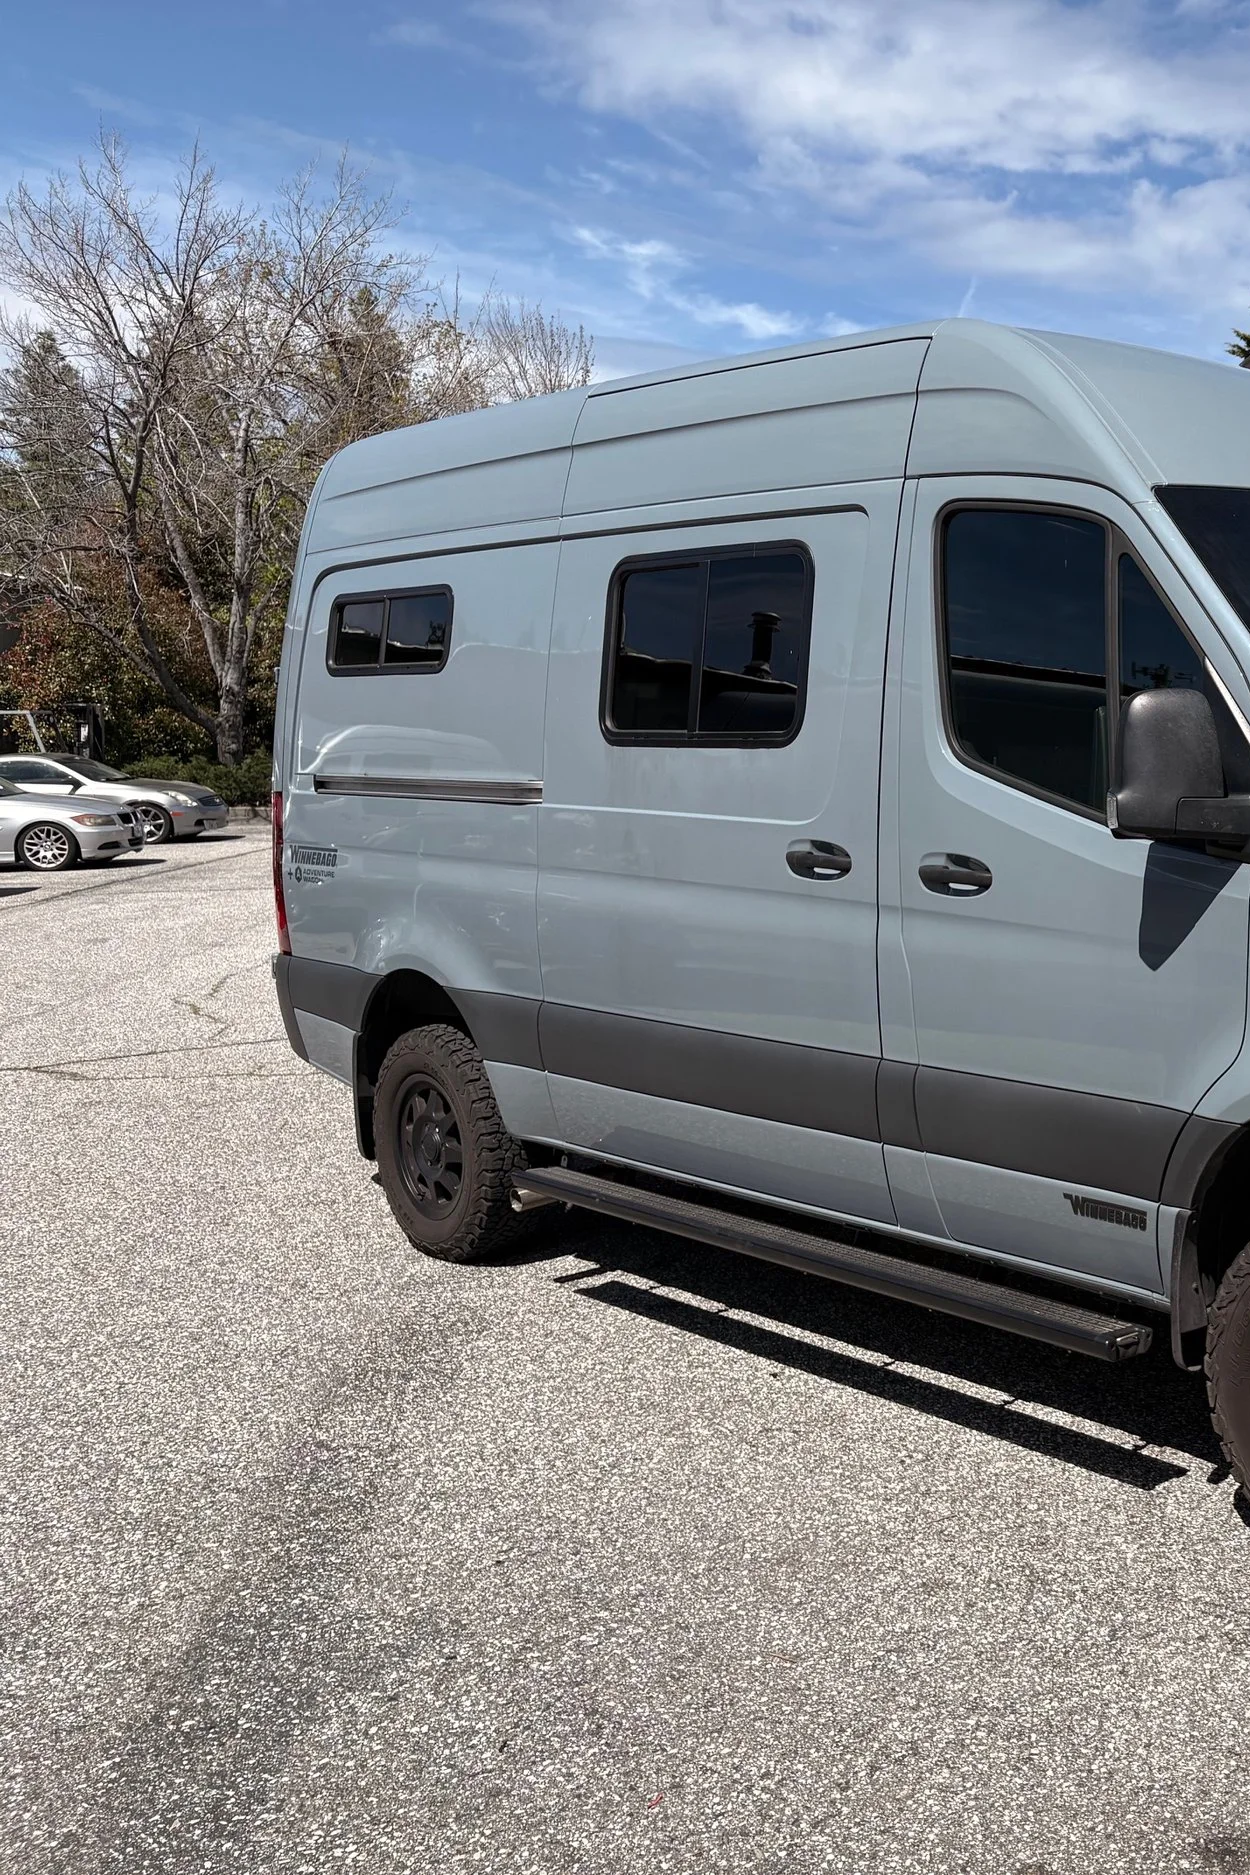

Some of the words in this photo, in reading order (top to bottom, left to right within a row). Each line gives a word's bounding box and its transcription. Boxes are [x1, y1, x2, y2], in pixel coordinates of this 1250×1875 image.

[289, 844, 338, 867] WINNEBAGO
[303, 868, 335, 878] ADVENTURE
[1063, 1192, 1147, 1232] WINNEBAGO
